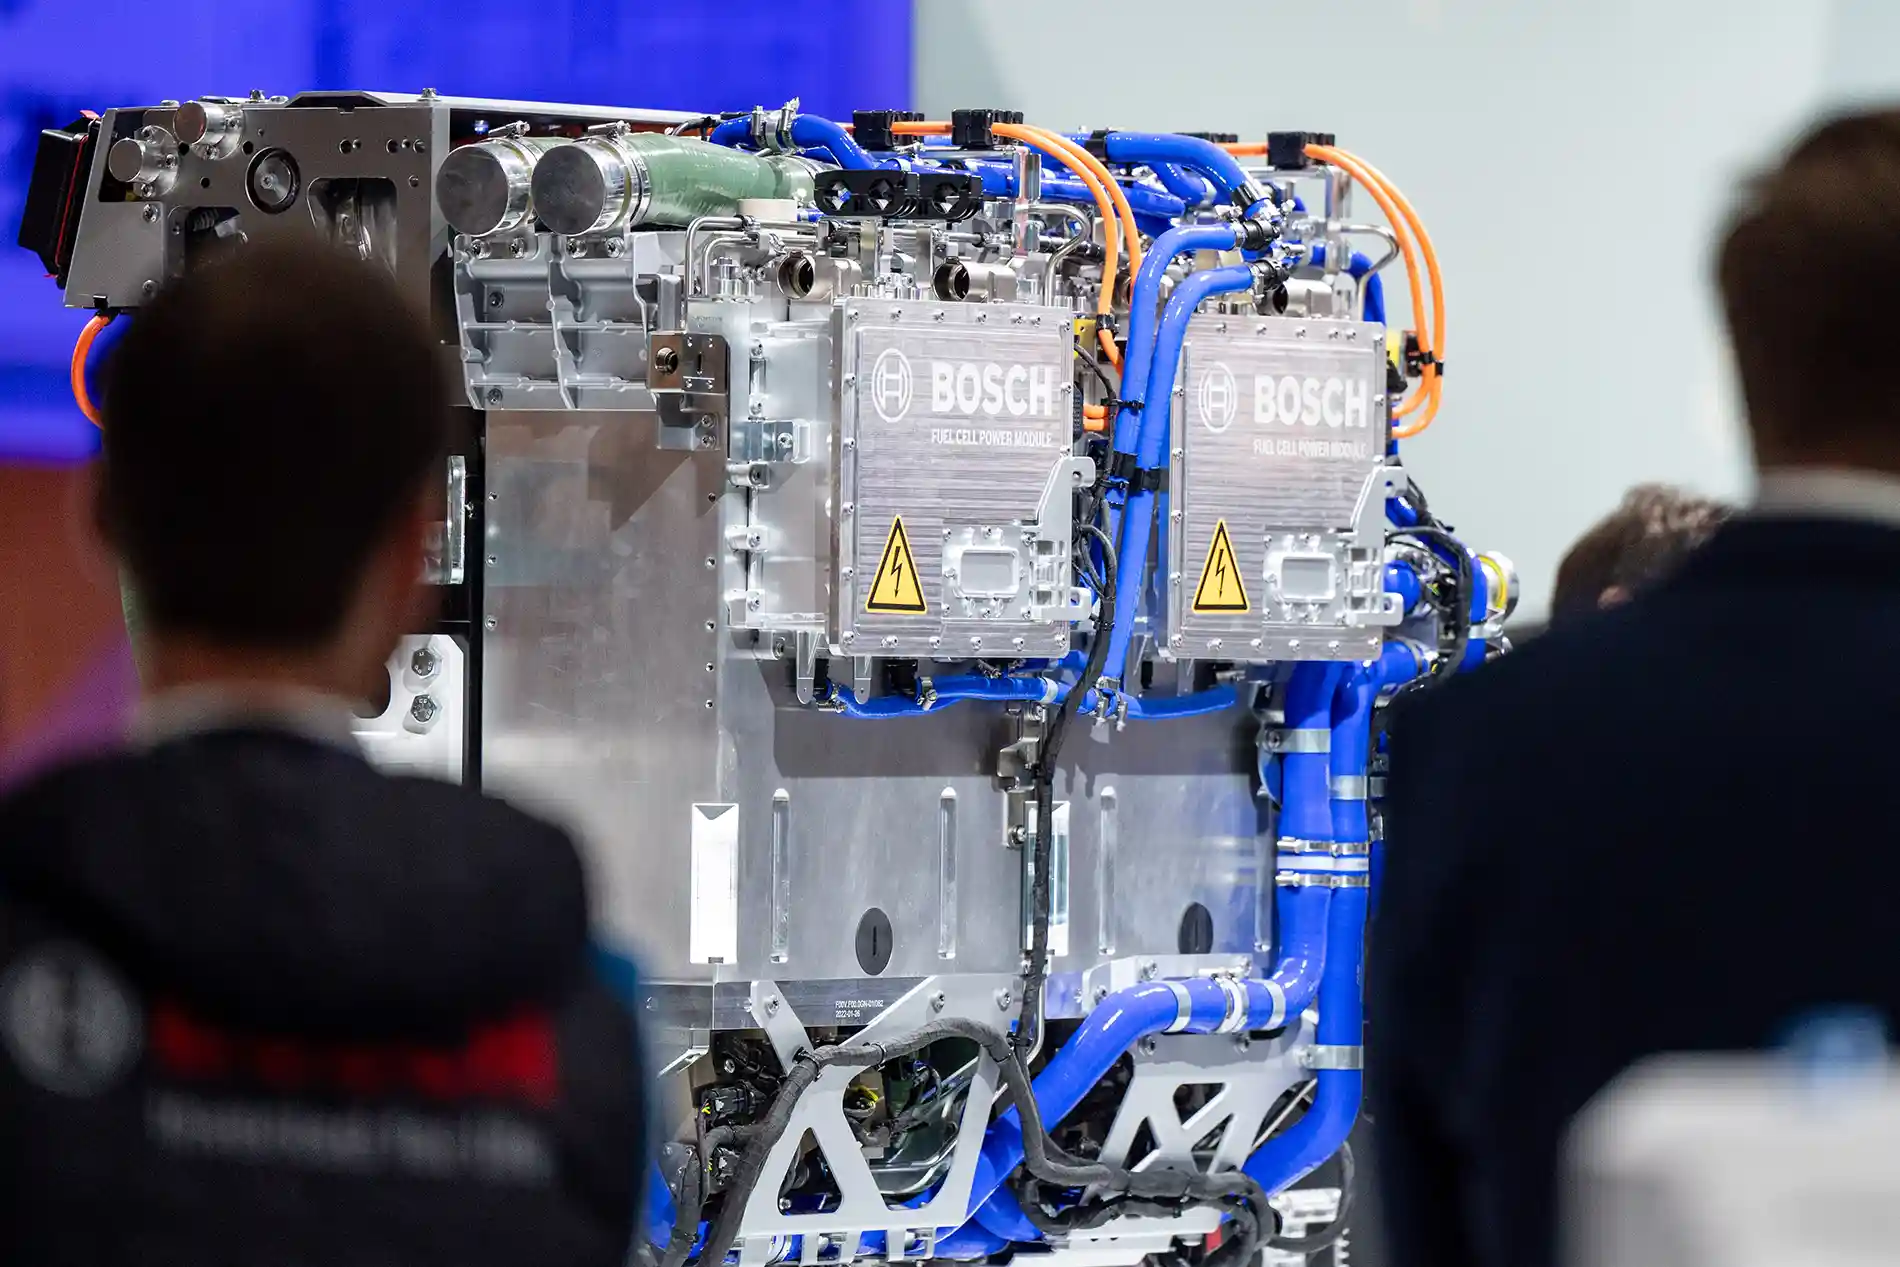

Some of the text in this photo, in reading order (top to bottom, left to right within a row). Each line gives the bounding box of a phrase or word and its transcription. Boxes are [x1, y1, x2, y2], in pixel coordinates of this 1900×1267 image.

[931, 361, 1053, 416] BOSCH
[1254, 375, 1367, 428] BOSCH
[932, 428, 1054, 448] FUEL CELL POWER MODULE
